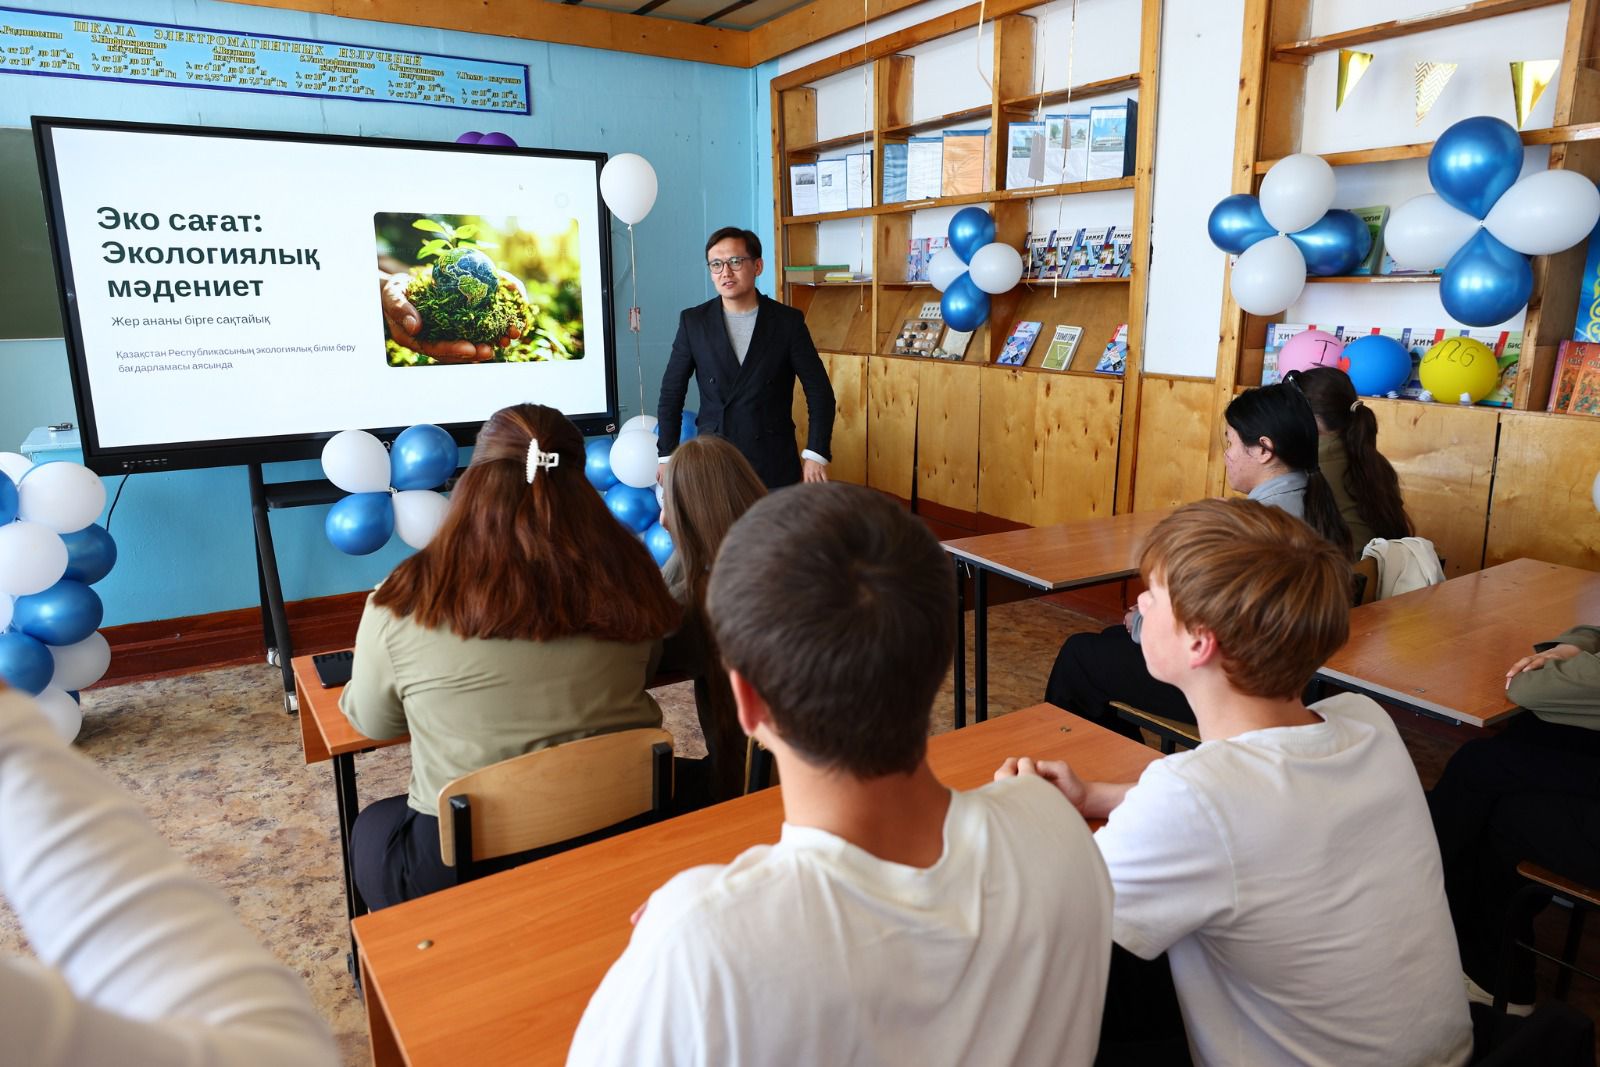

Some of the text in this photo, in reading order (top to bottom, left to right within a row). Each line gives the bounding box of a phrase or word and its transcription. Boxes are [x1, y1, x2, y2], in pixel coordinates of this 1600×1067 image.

[74, 20, 422, 66] ШКАЛА ЭЛЕКТРОМАГНИТНЫХ ИЗЛУЧЕНИЙ
[96, 206, 262, 232] Эко сағат:
[102, 240, 320, 270] Экологиялық
[108, 280, 264, 302] мәдениет
[112, 314, 270, 328] Жер ананы бірге сақтайық
[116, 343, 356, 360] Қазақстан Республикасының экологиялық білім беру
[192, 362, 234, 371] аясында
